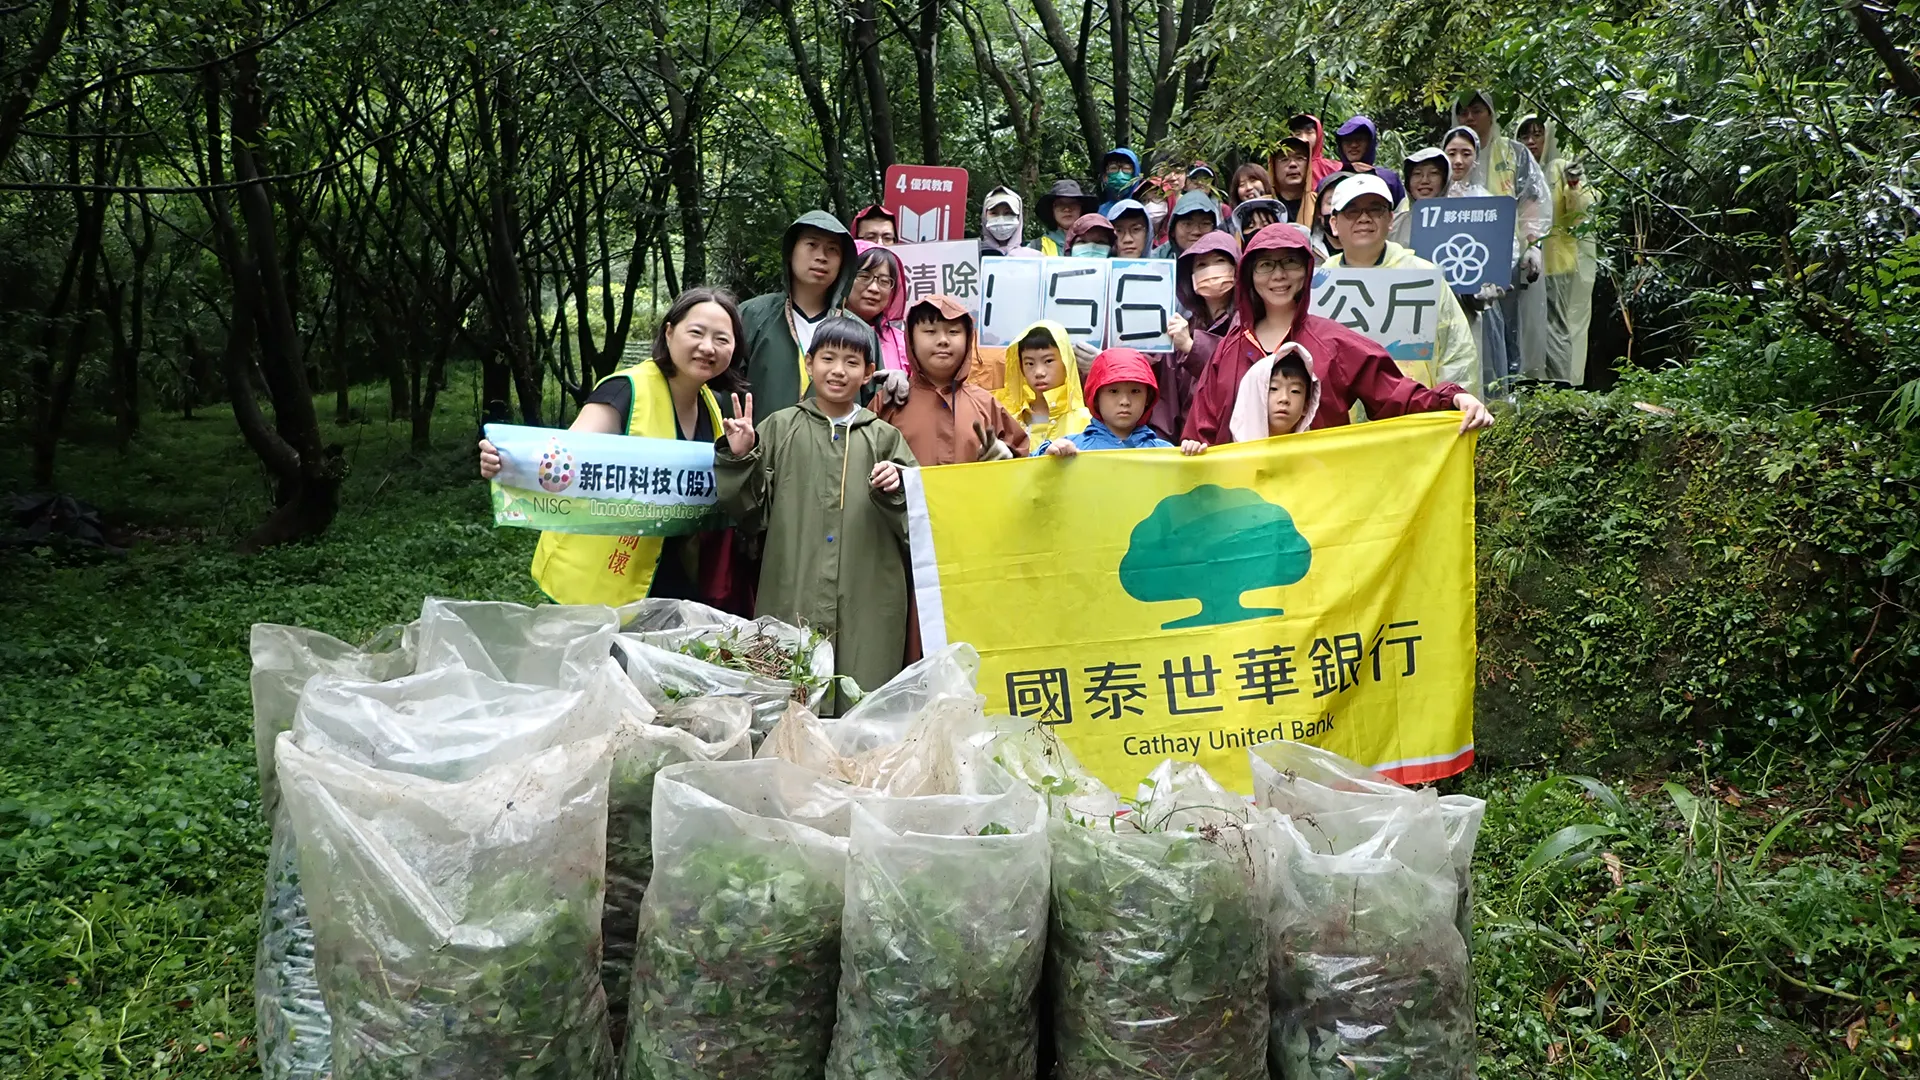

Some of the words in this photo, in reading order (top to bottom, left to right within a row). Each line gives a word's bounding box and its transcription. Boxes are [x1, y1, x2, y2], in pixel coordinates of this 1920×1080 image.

[896, 173, 907, 193] 4
[910, 178, 954, 192] 優質教育
[1420, 206, 1441, 228] 17
[1443, 208, 1498, 223] 夥伴關係
[903, 260, 979, 301] 清除
[984, 268, 1167, 341] 156
[1318, 278, 1436, 334] 公斤
[579, 462, 717, 497] 新印科技(股)
[533, 496, 572, 515] NISC
[590, 499, 671, 522] Innovating
[672, 502, 695, 519] the
[1005, 619, 1423, 725] 國泰世華銀行
[1123, 734, 1200, 757] Cathay
[1209, 722, 1283, 750] United
[1291, 712, 1335, 740] Bank
